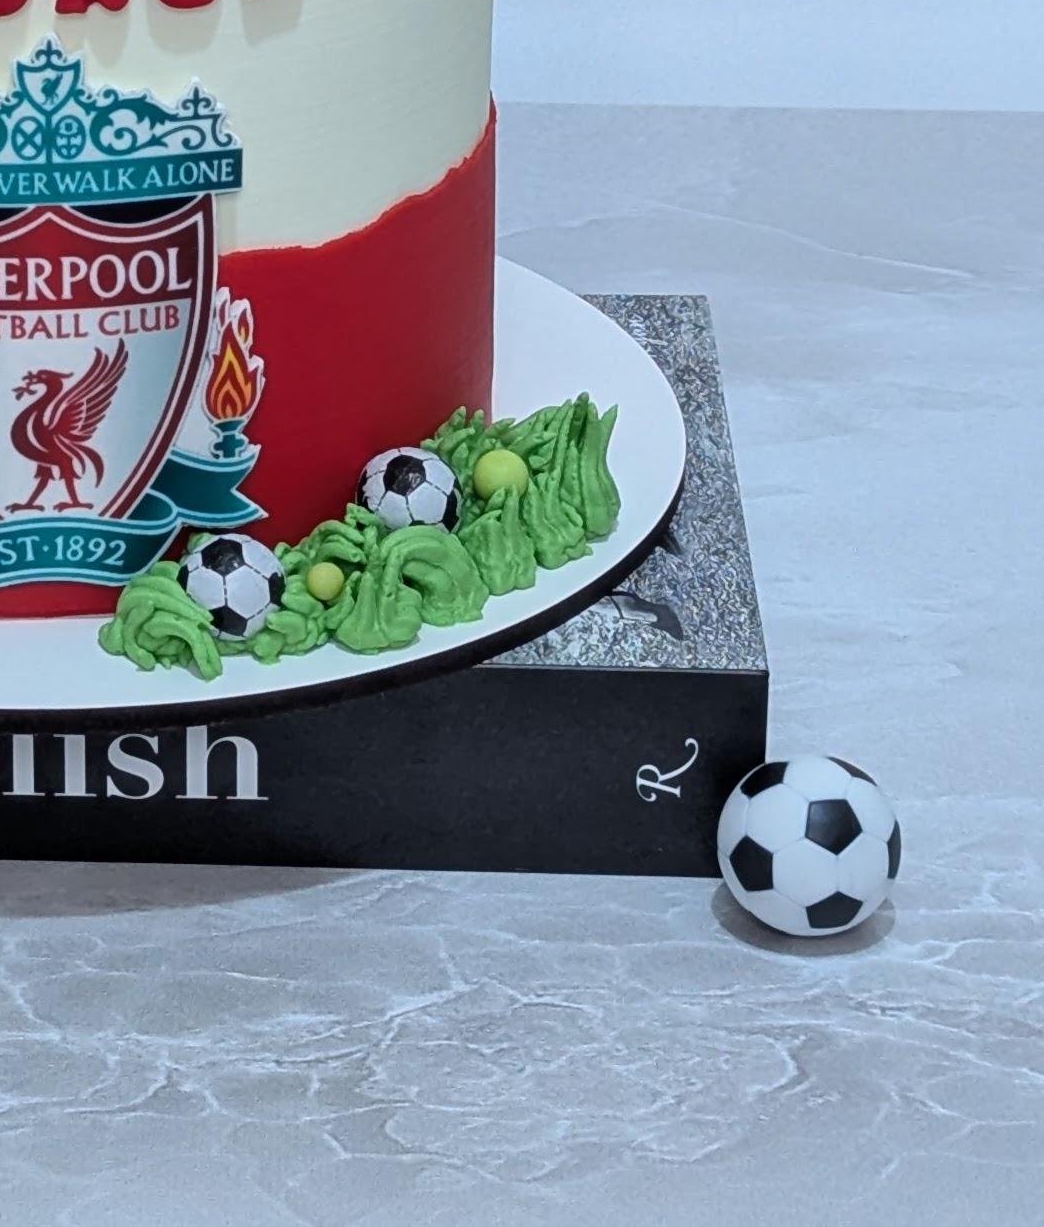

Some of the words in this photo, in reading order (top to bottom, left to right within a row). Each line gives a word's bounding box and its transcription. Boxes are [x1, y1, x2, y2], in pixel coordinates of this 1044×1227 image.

[52, 166, 137, 195] WALK
[141, 158, 236, 189] ALONE
[97, 303, 181, 338] CLUB
